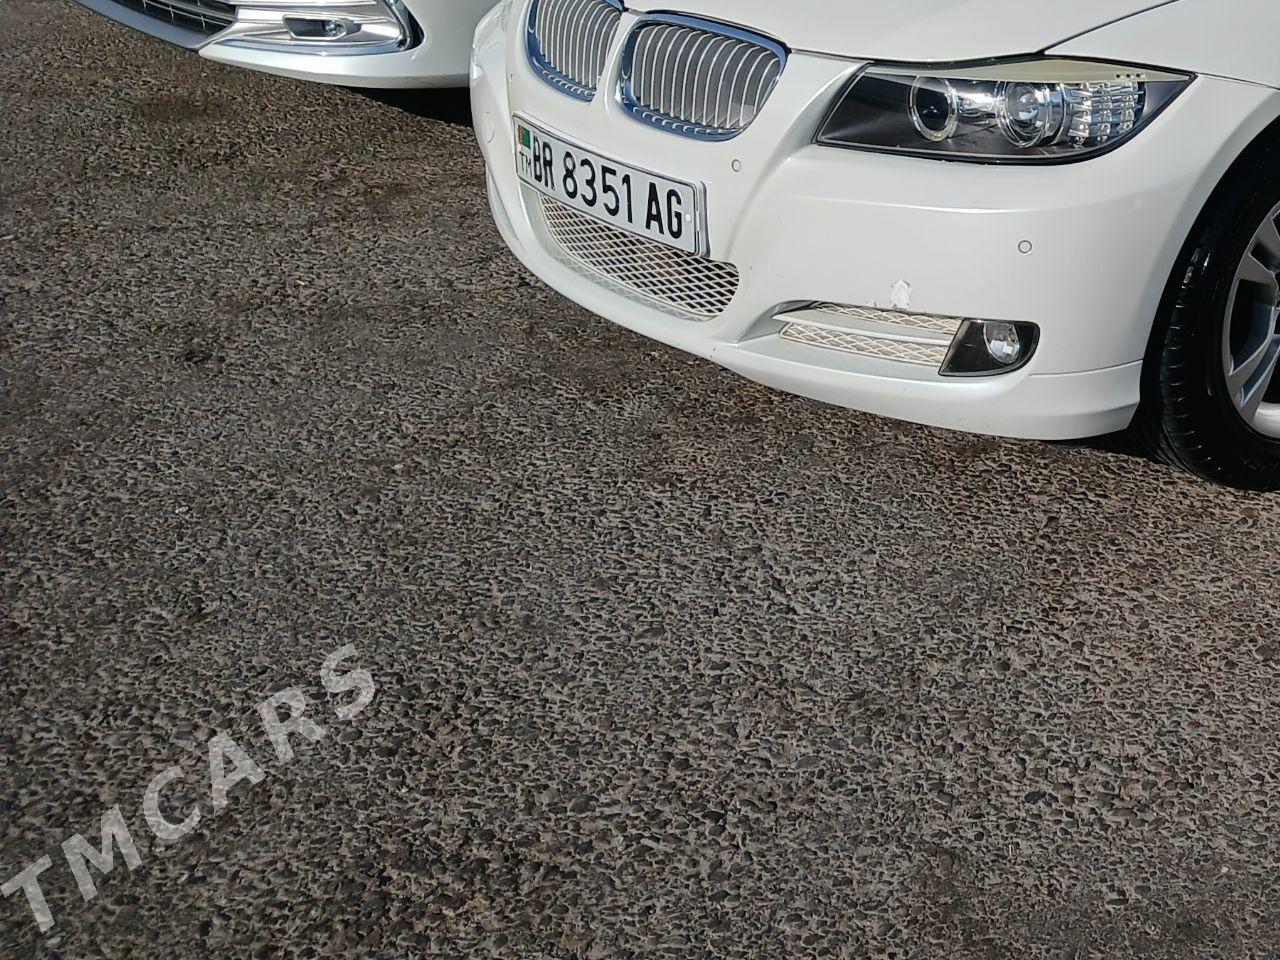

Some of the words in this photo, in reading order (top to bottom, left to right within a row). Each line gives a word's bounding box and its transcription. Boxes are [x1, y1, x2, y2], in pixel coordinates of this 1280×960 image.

[533, 136, 556, 191] BR
[562, 151, 634, 224] 8351
[645, 181, 683, 239] AG
